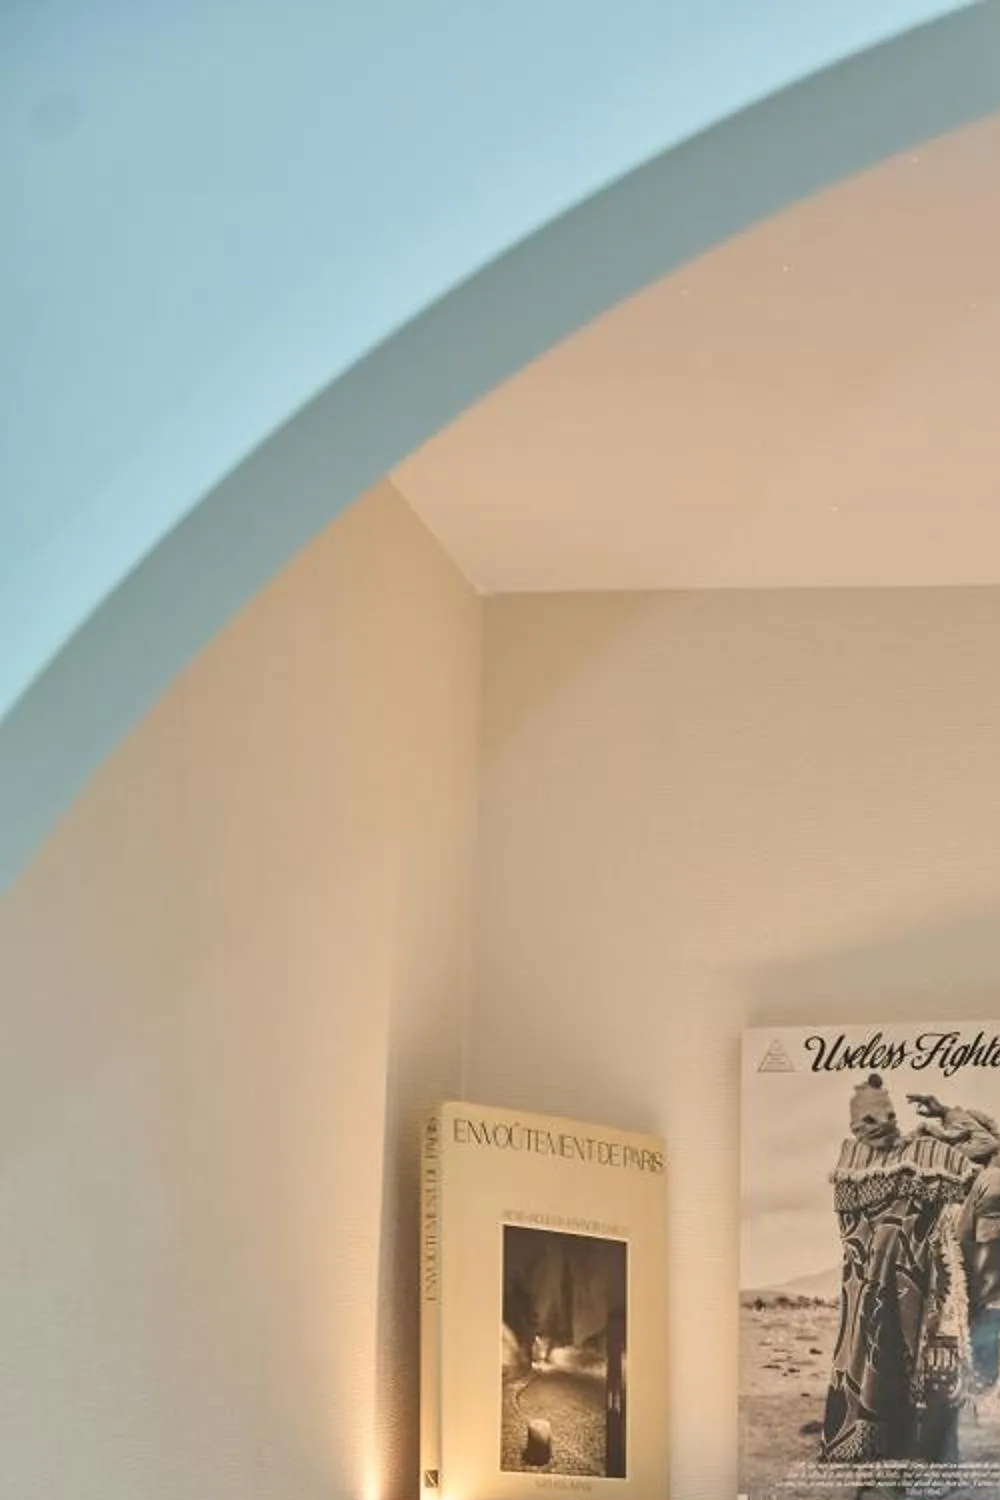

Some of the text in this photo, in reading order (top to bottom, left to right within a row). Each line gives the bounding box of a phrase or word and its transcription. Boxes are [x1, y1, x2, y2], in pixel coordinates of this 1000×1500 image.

[804, 1032, 911, 1073] Useless
[597, 1141, 621, 1167] DE
[622, 1145, 664, 1173] PARIS
